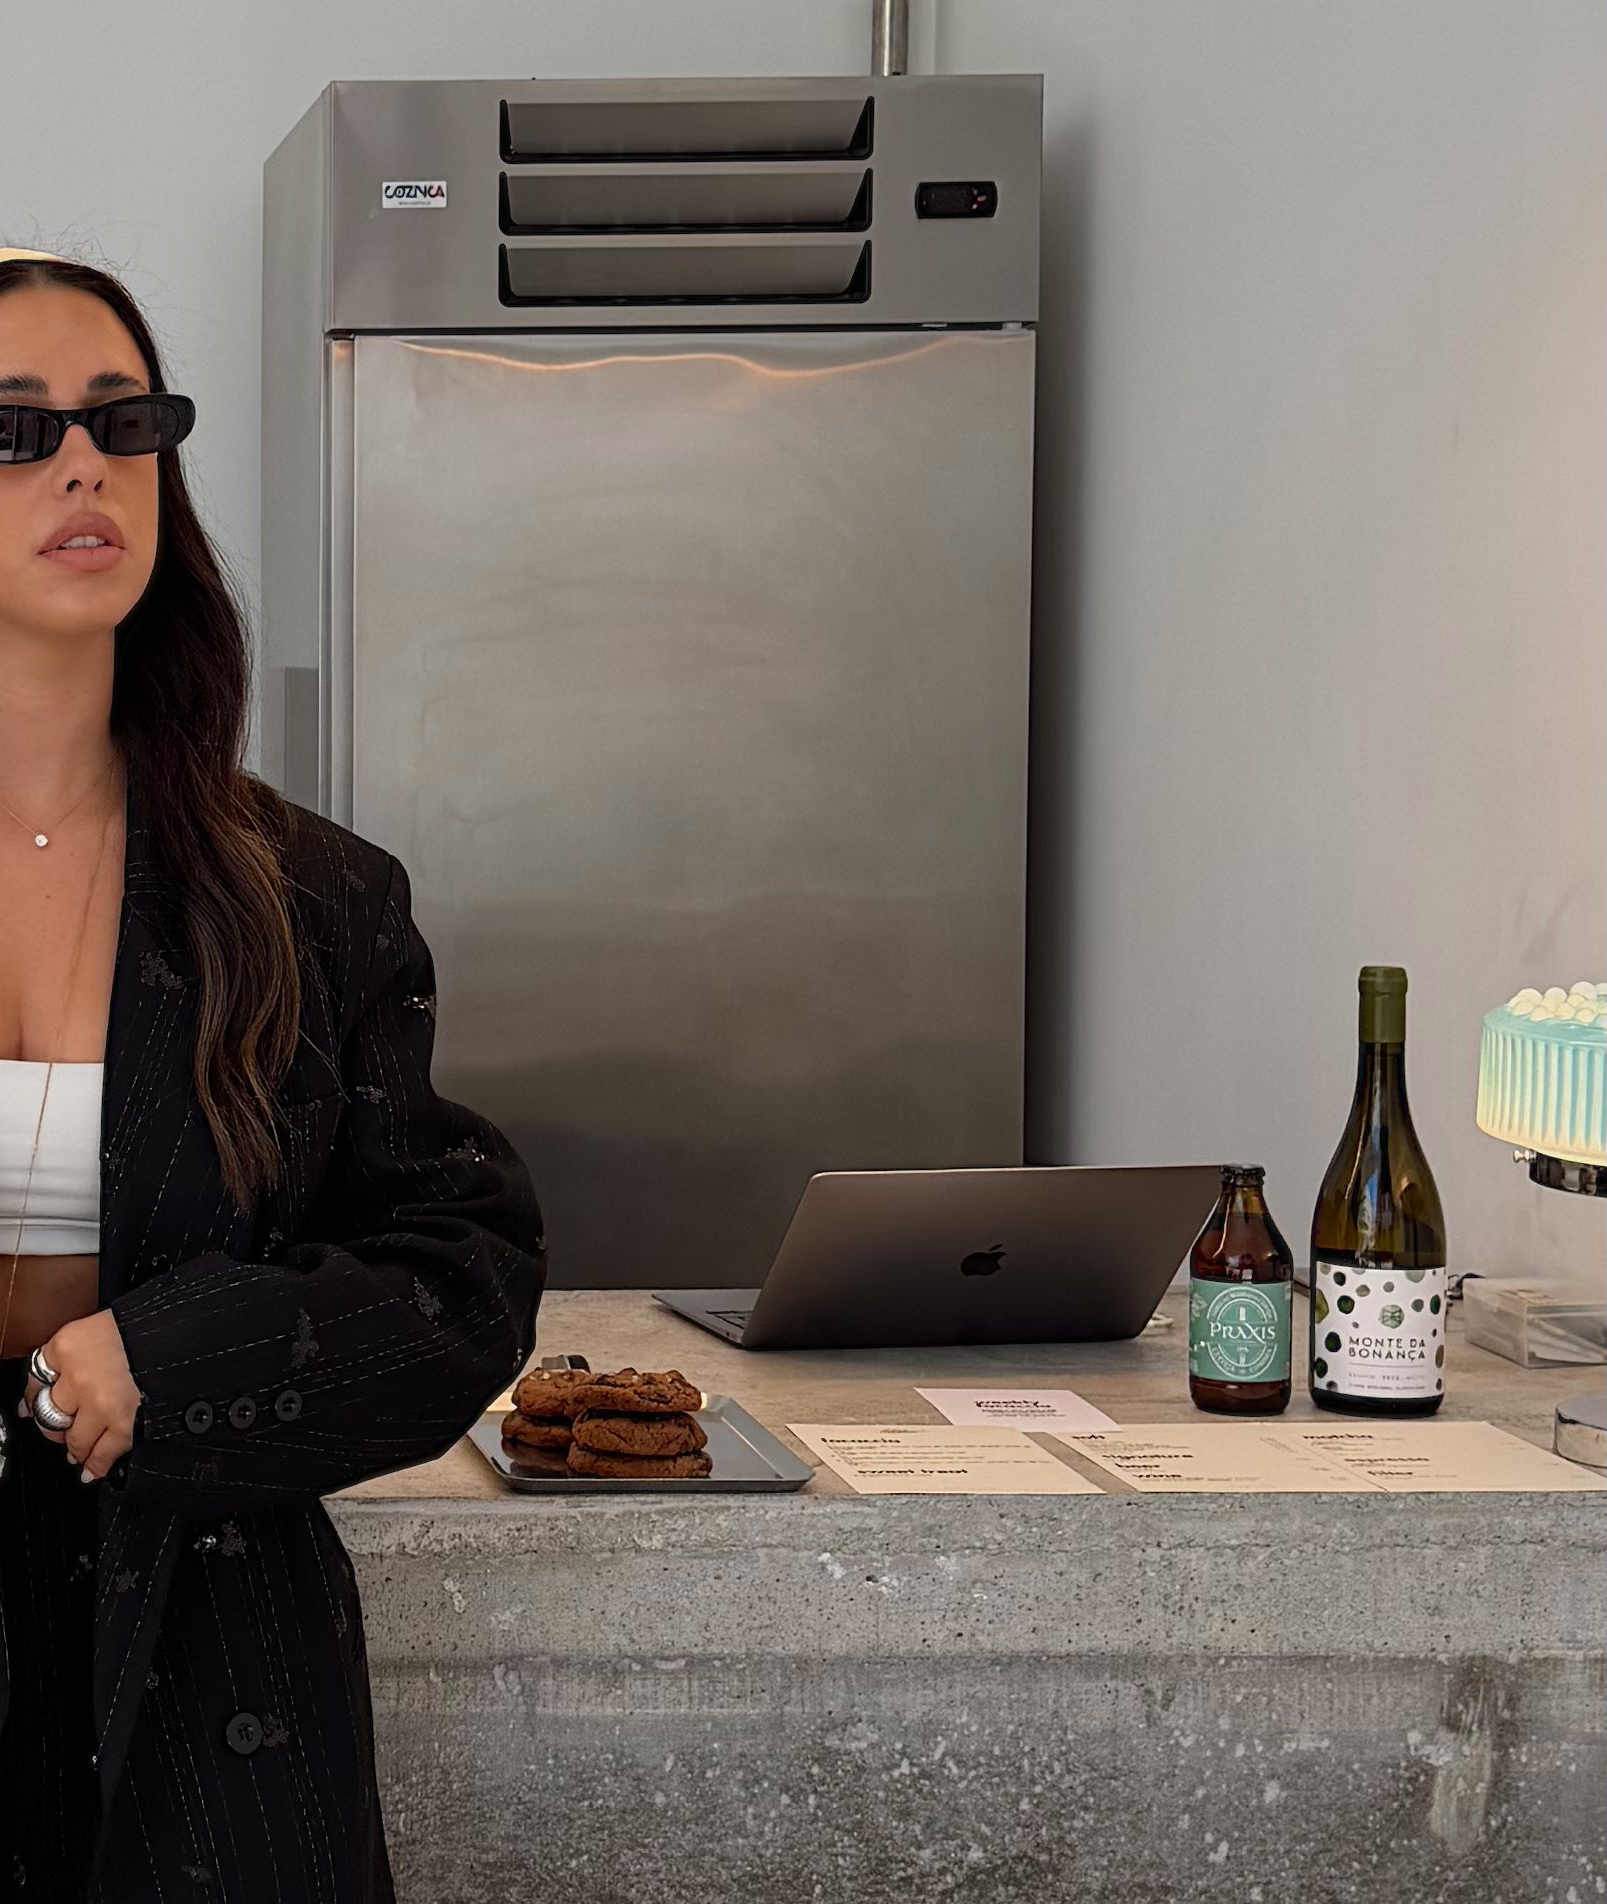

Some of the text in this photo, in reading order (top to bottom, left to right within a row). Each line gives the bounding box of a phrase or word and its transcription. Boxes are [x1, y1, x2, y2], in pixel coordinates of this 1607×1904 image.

[1348, 1336, 1426, 1349] MONTE DA
[1348, 1348, 1426, 1362] BONANÇA
